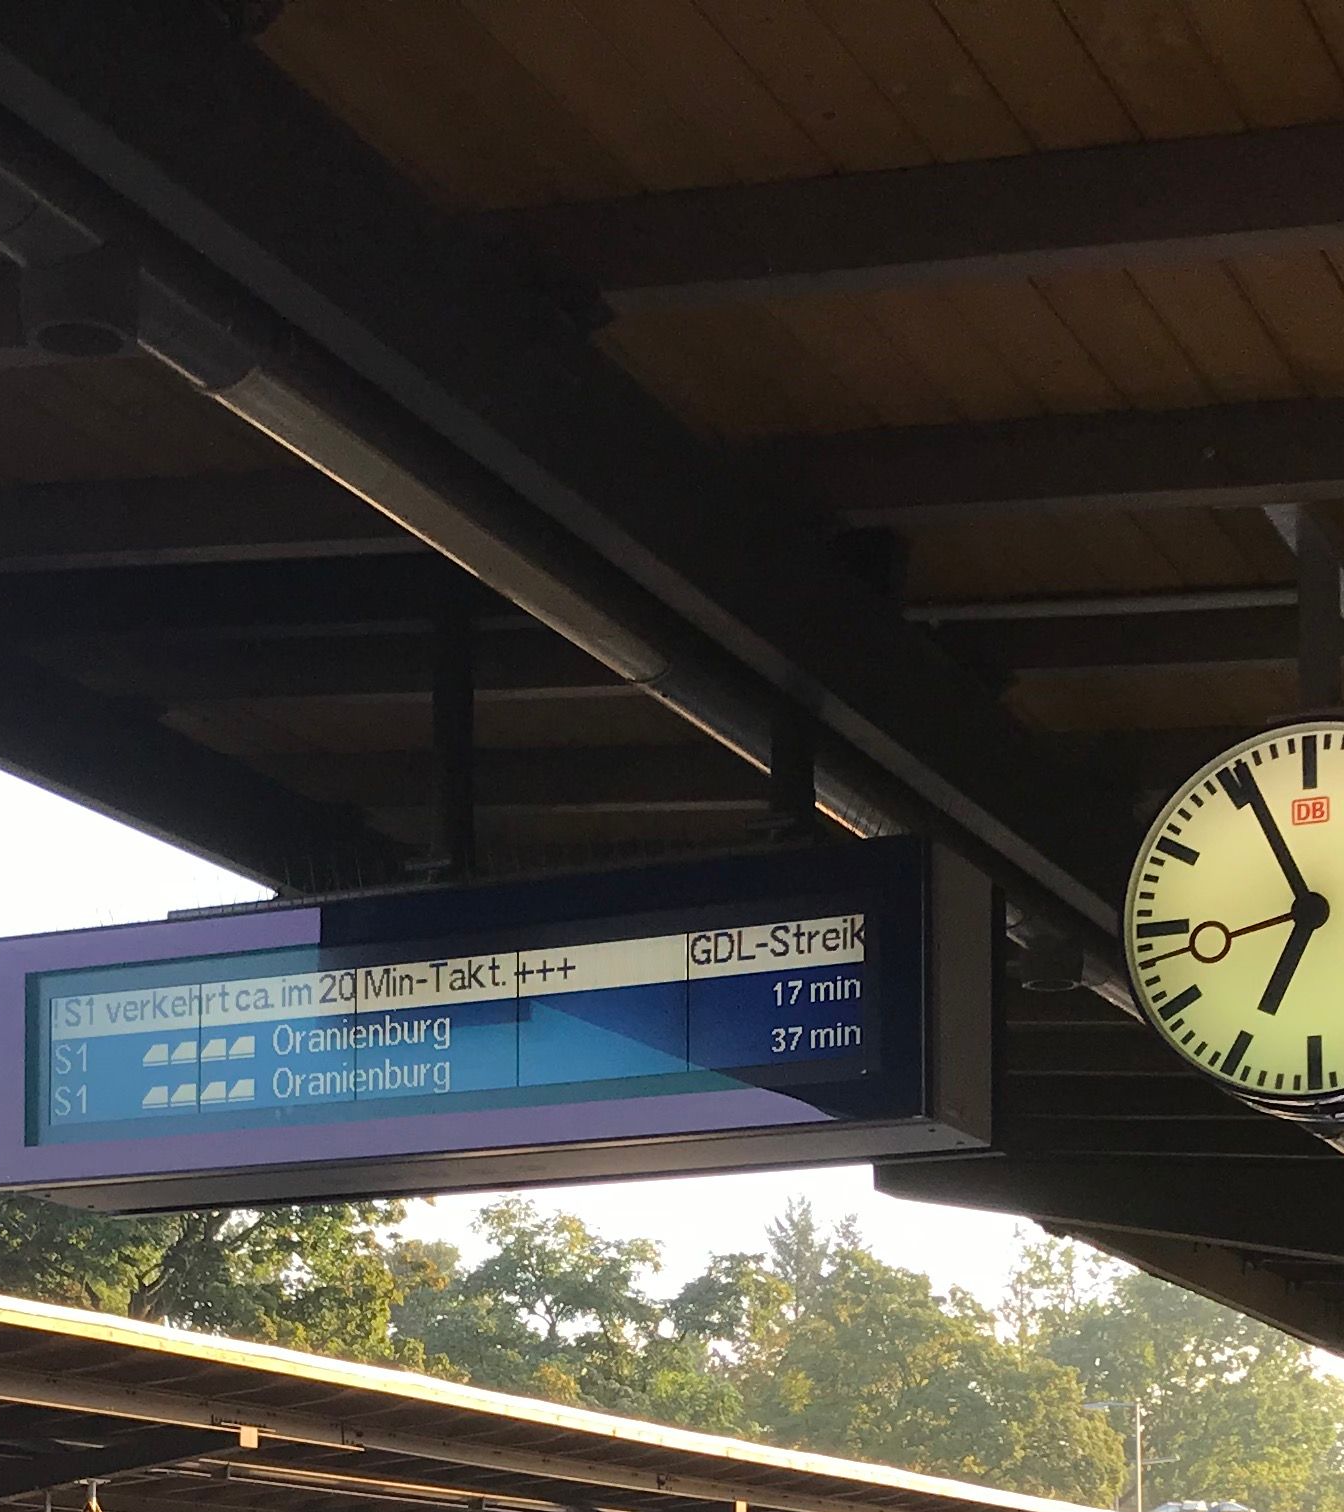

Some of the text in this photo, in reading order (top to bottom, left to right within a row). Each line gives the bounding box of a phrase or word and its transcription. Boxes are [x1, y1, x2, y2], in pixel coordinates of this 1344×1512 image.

[1296, 800, 1326, 821] DB
[64, 996, 95, 1028] S1
[106, 986, 230, 1024] verkehrt
[281, 979, 313, 1008] im
[318, 969, 357, 1004] 20
[363, 956, 507, 1000] Min-Takt.
[689, 917, 865, 966] GDL-Streik
[55, 975, 862, 1076] S1 Oranienburg 17 min
[55, 1022, 862, 1118] S1 Oranienburg 37 min
